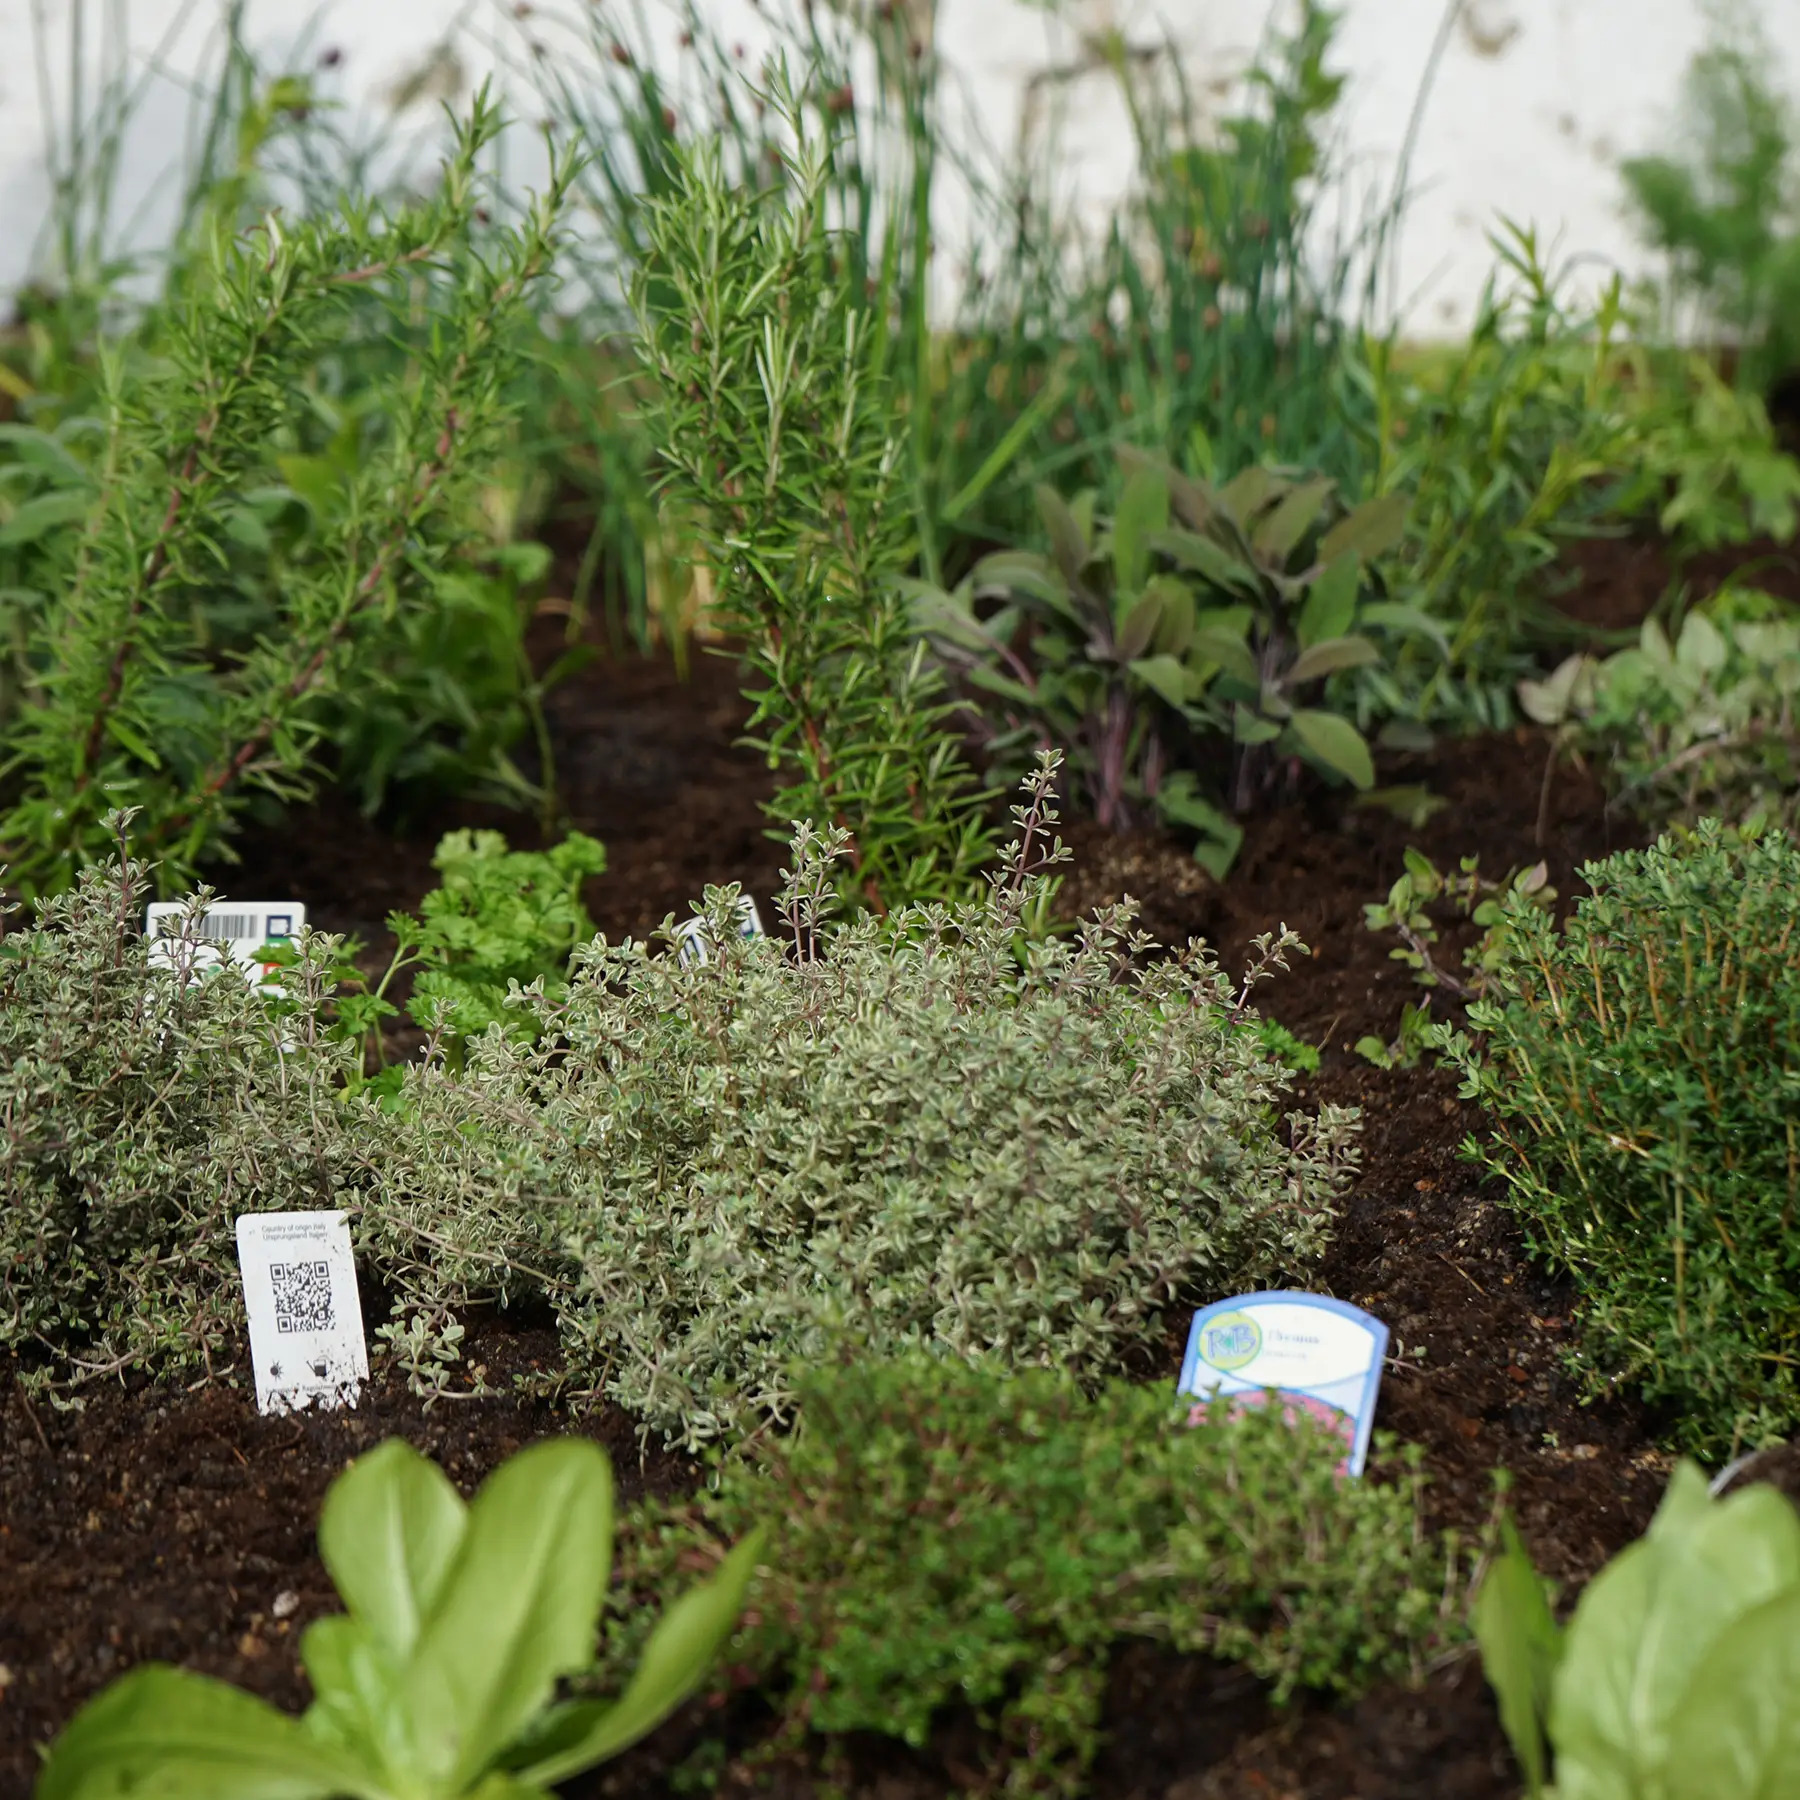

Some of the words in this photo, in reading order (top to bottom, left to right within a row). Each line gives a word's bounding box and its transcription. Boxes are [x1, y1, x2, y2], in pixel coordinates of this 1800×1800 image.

[261, 1224, 286, 1234] Country
[287, 1224, 294, 1232] of
[295, 1223, 312, 1233] origin
